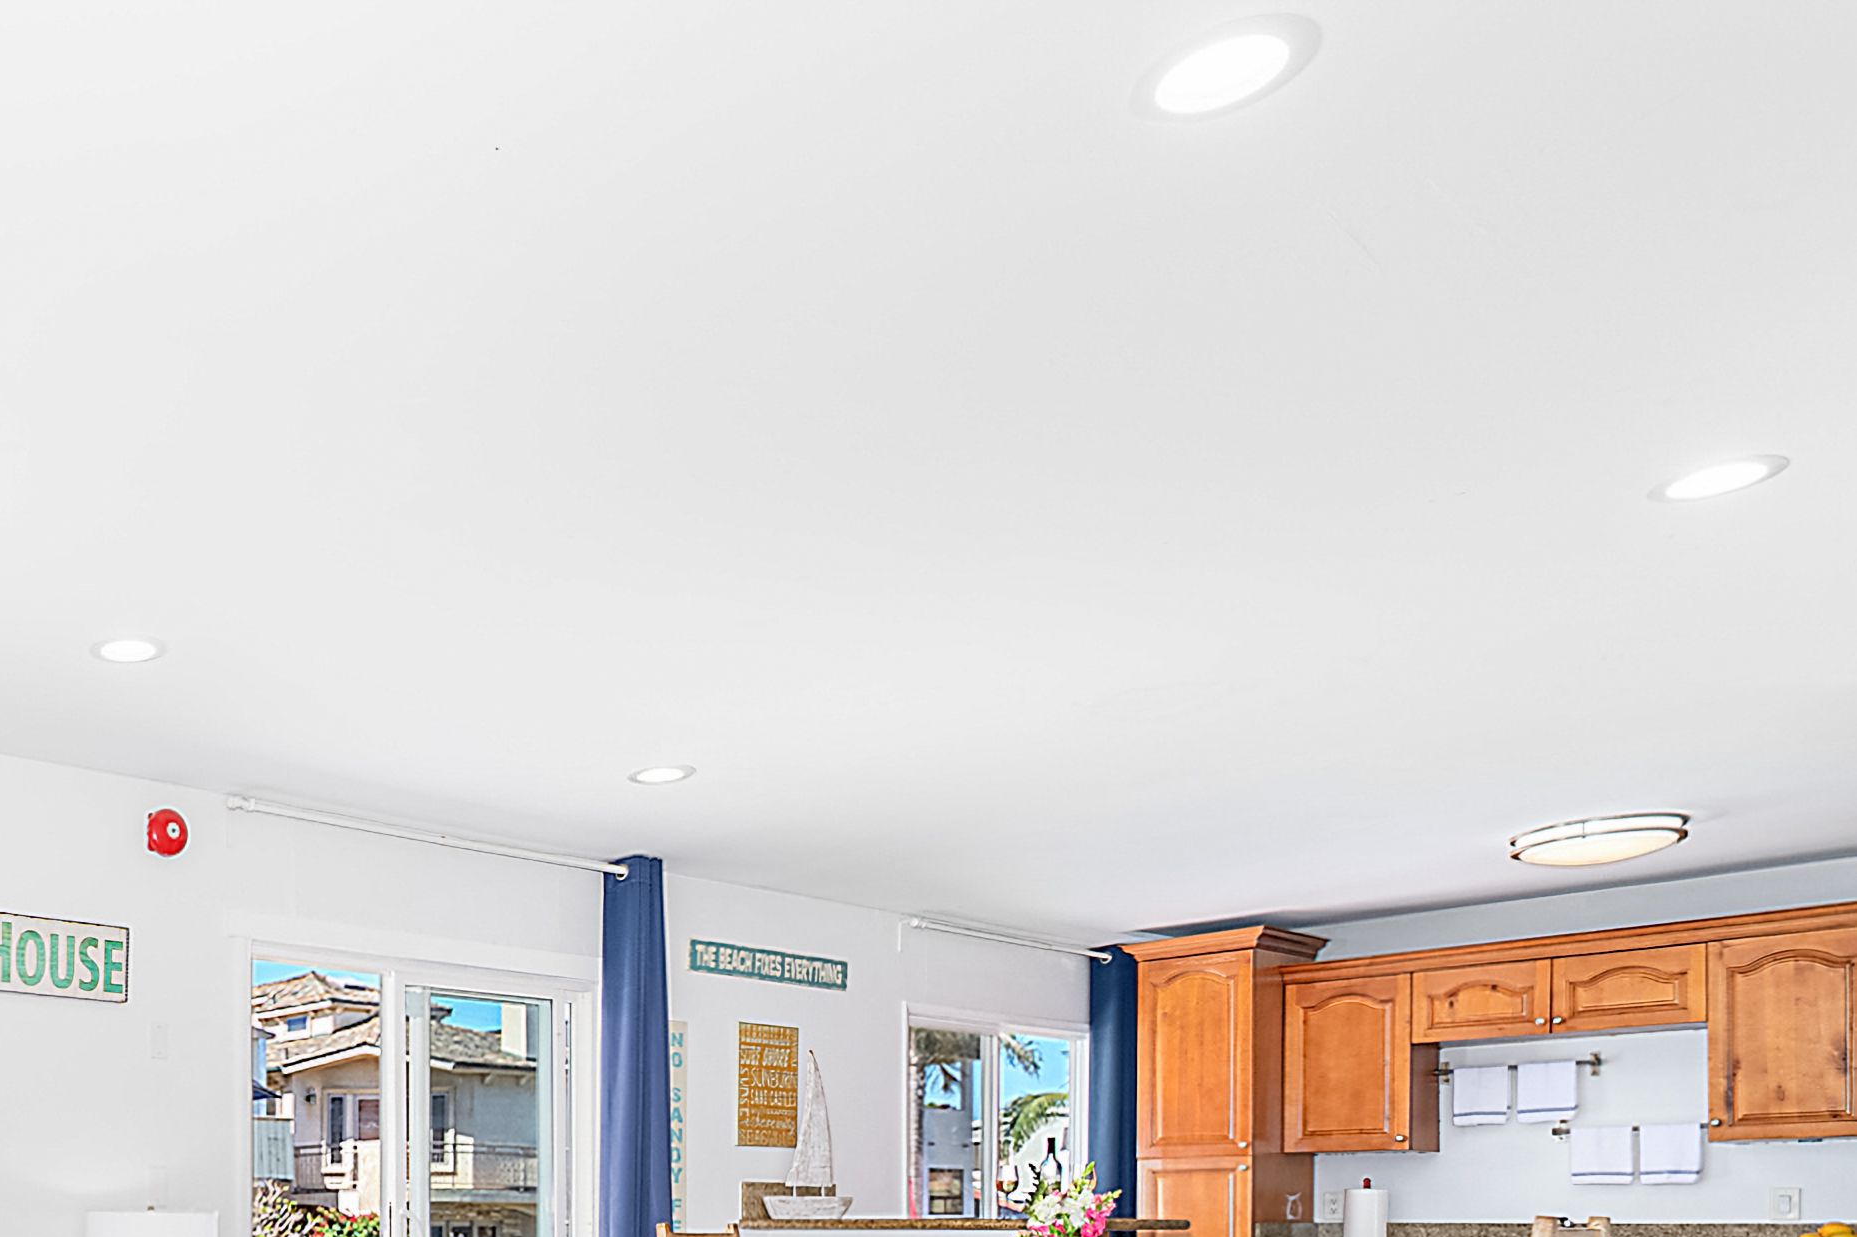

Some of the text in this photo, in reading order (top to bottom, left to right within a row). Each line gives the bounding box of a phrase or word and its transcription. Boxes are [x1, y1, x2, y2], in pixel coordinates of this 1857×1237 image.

[695, 943, 843, 985] THE BEACH FIXES EVERYTHING
[671, 1031, 684, 1069] NO
[670, 1086, 684, 1185] SANDY
